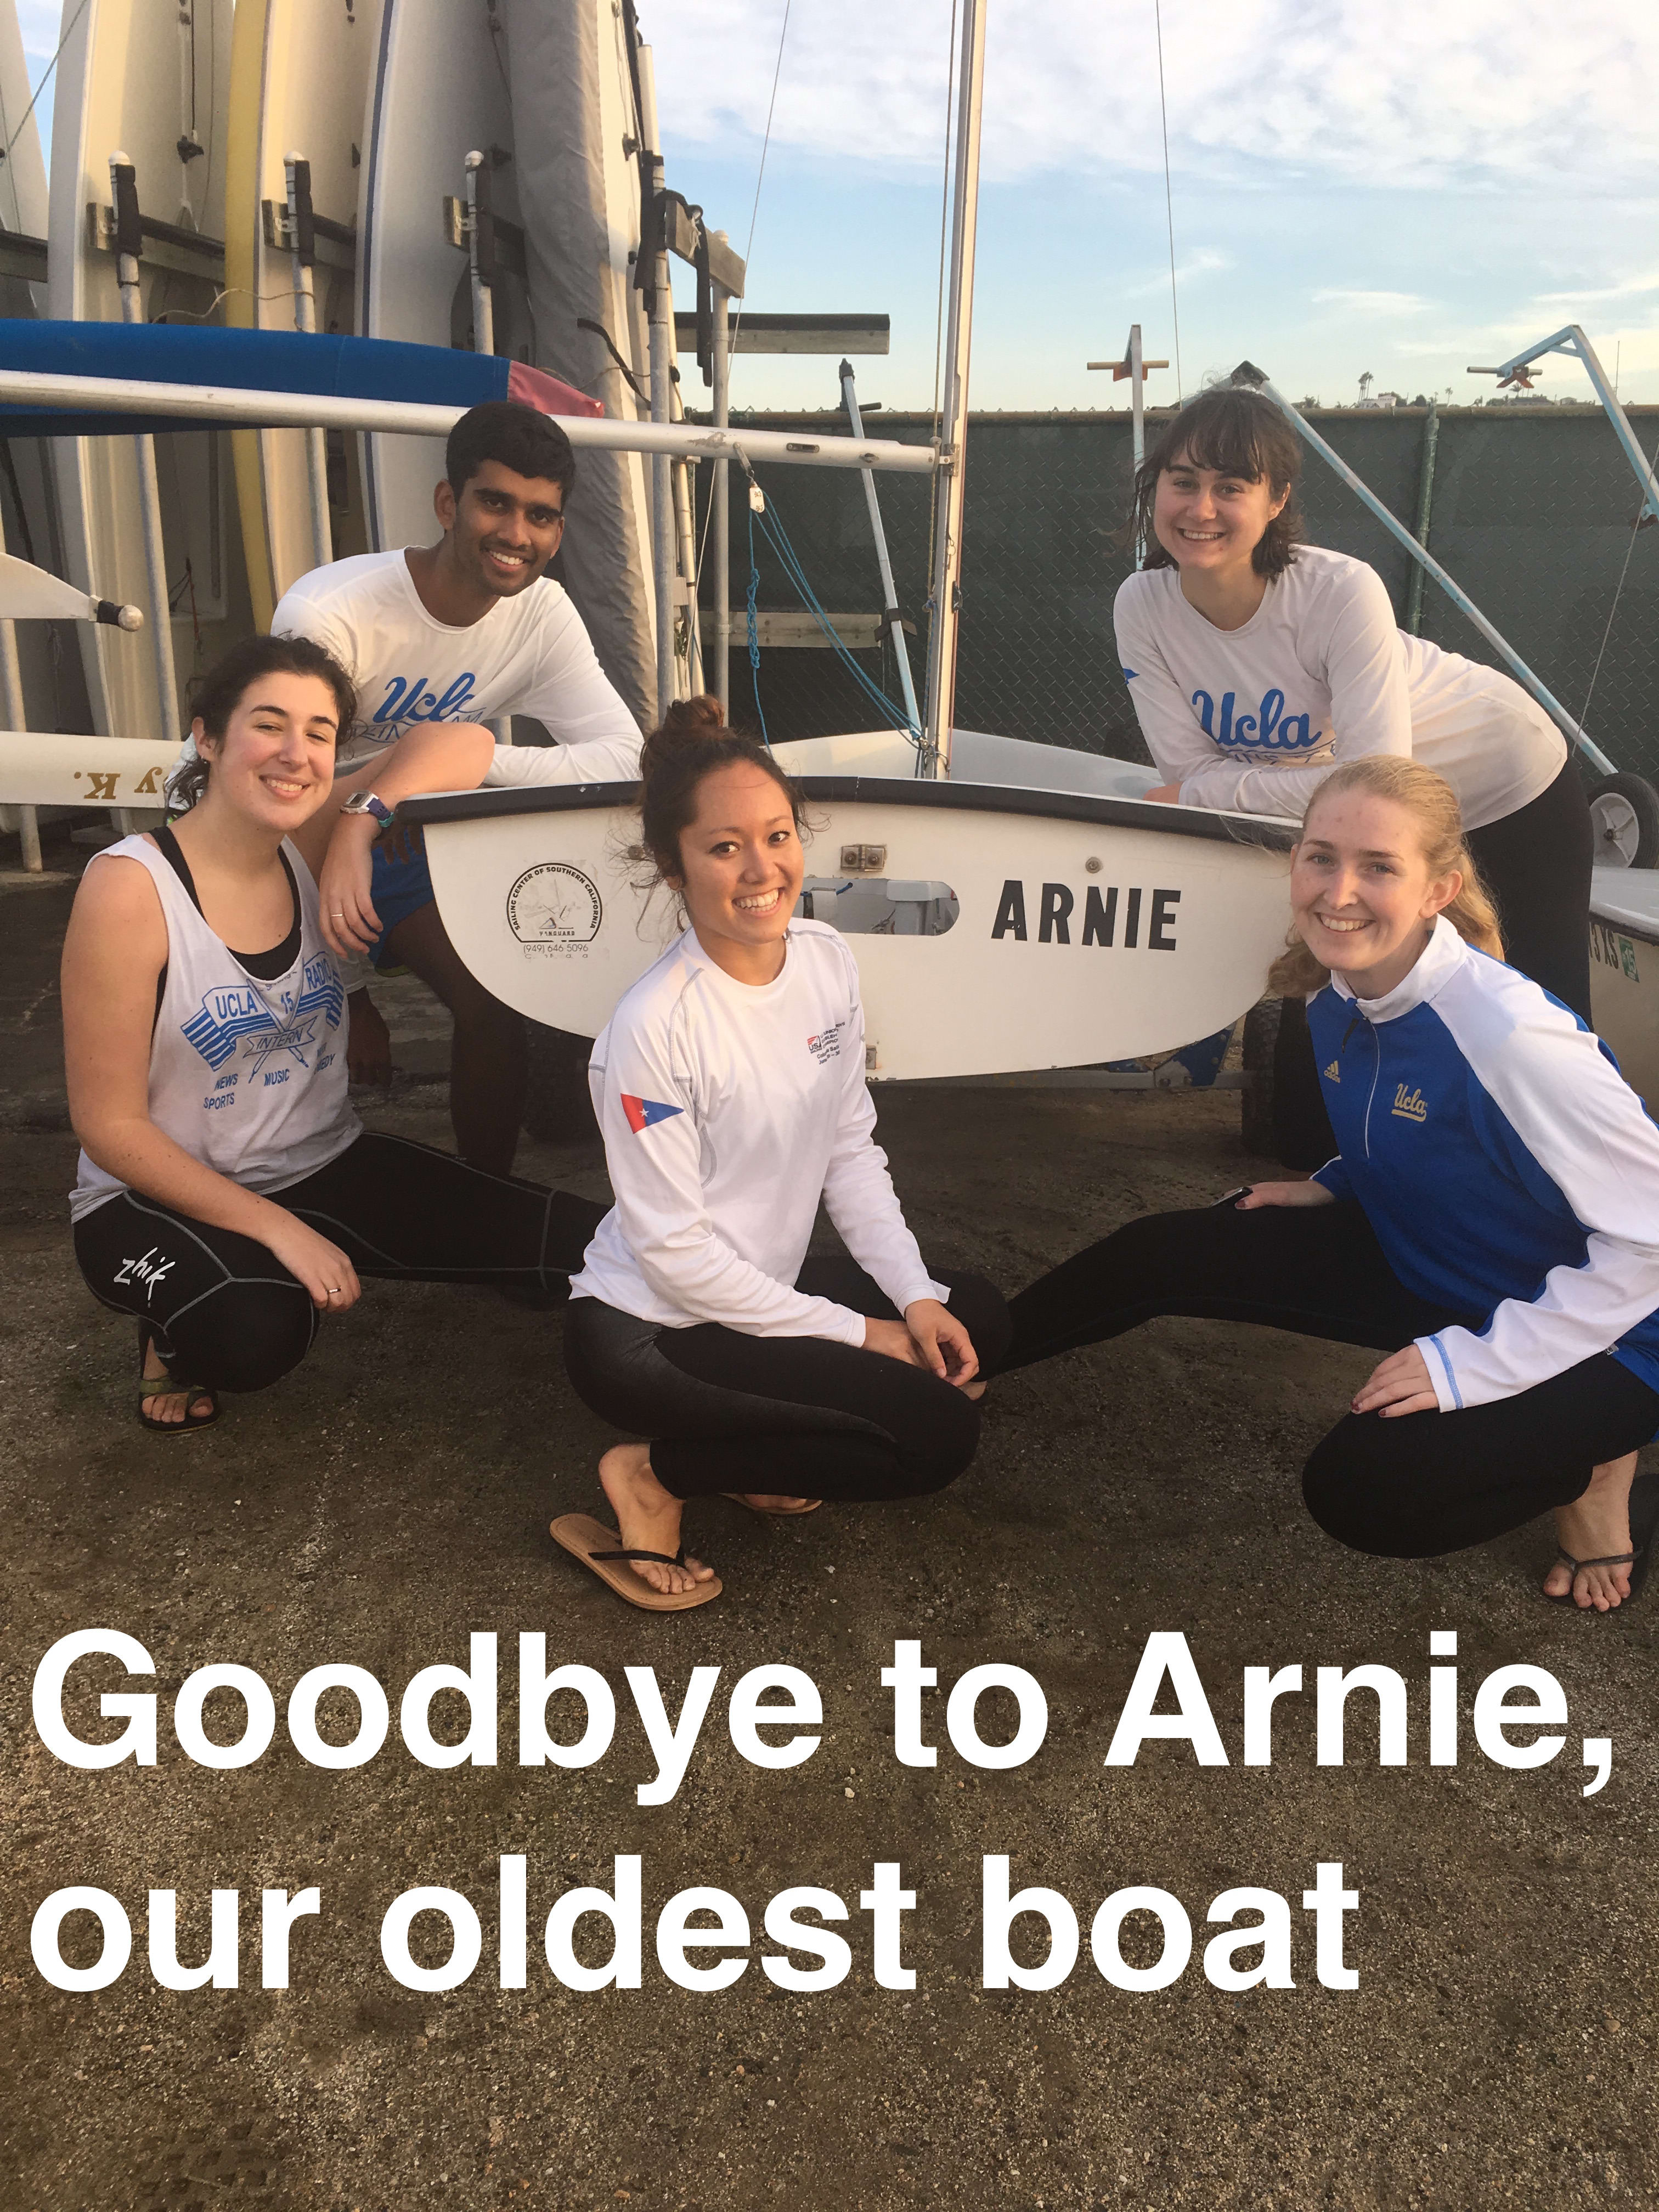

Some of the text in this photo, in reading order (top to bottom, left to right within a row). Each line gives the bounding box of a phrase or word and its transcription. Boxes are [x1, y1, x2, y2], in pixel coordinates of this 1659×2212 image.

[1192, 688, 1322, 750] Ucla
[74, 771, 122, 800] K.
[510, 866, 599, 930] SAILING CENTER OF SOUTHERN CALIFORNIA
[990, 879, 1182, 951] ARNIE
[523, 943, 589, 954] (949) 646 5096
[215, 991, 258, 1020] UCLA
[256, 1028, 303, 1051] INTERN
[214, 1073, 239, 1092] NEWS
[264, 1068, 290, 1087] MUSIC
[203, 1092, 235, 1110] SPORTS
[1392, 1082, 1427, 1121] Ucla
